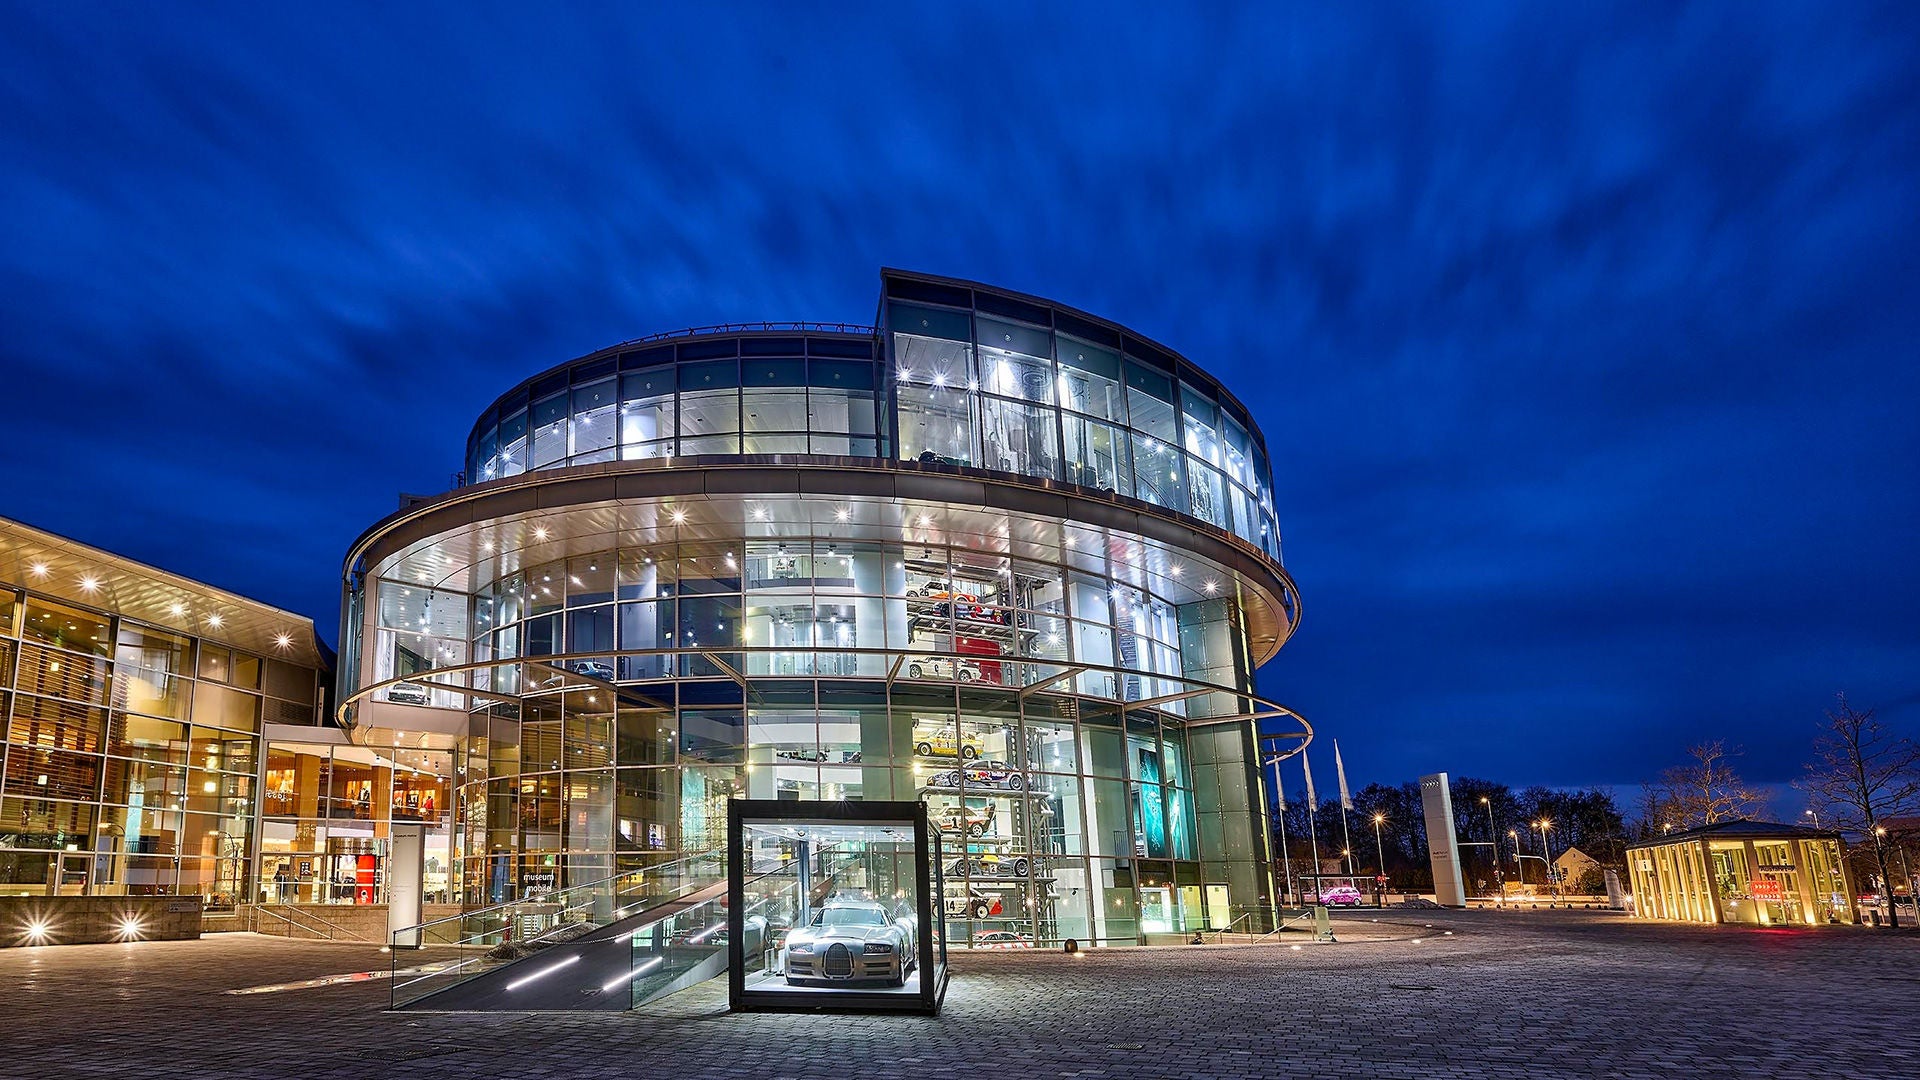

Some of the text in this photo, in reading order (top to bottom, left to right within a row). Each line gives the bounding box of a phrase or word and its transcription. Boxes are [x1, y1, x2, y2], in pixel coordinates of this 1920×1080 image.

[920, 588, 929, 597] 26
[952, 817, 958, 829] 1
[945, 900, 956, 912] 14
